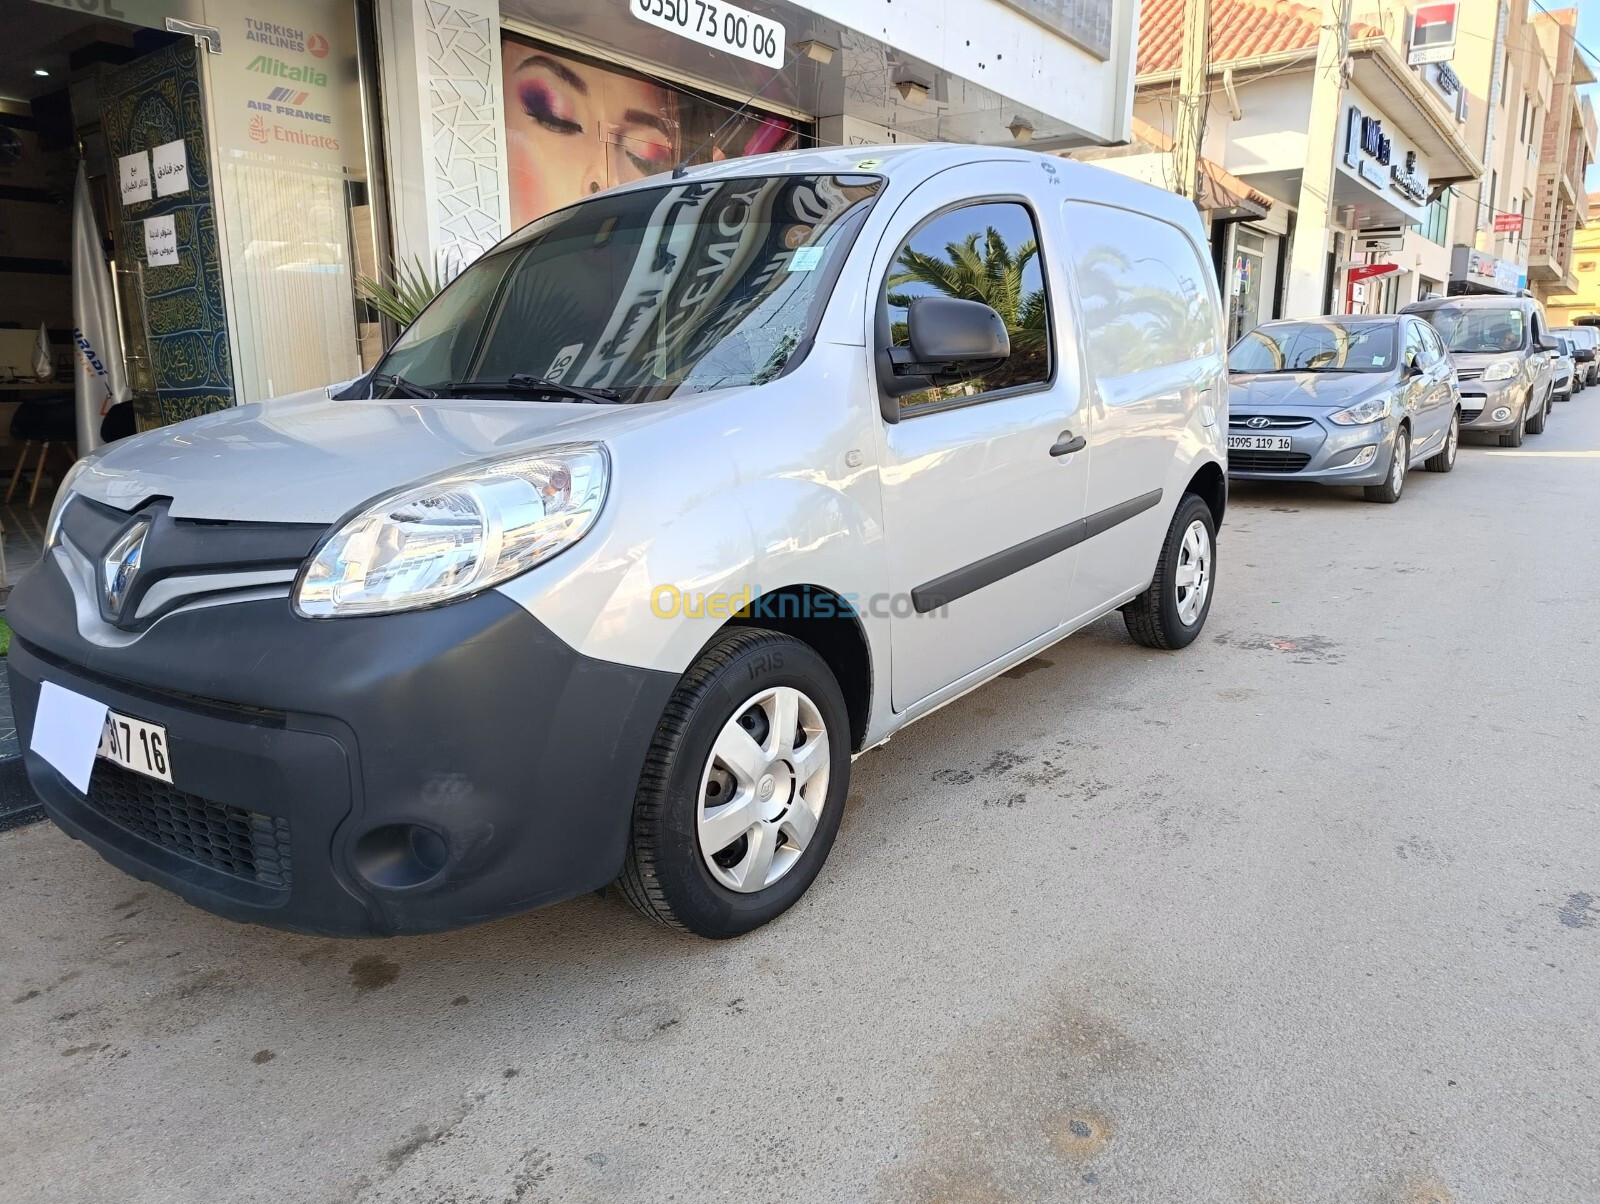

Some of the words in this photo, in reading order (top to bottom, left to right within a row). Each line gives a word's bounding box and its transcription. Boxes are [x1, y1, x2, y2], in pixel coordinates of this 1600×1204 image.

[245, 18, 304, 40] TURKISH
[246, 30, 304, 52] AIRLINES
[695, 0, 717, 37] 73
[724, 13, 747, 48] 00
[753, 24, 776, 58] 06
[245, 55, 327, 87] Alitalia
[247, 100, 272, 112] AIR
[276, 105, 331, 124] FRANCE
[273, 125, 340, 150] Emirates
[157, 162, 173, 179] فنادق
[173, 163, 184, 175] حجز
[1255, 438, 1273, 449] 119
[1278, 439, 1290, 450] 16
[747, 651, 784, 680] IRIS
[140, 728, 166, 775] 16
